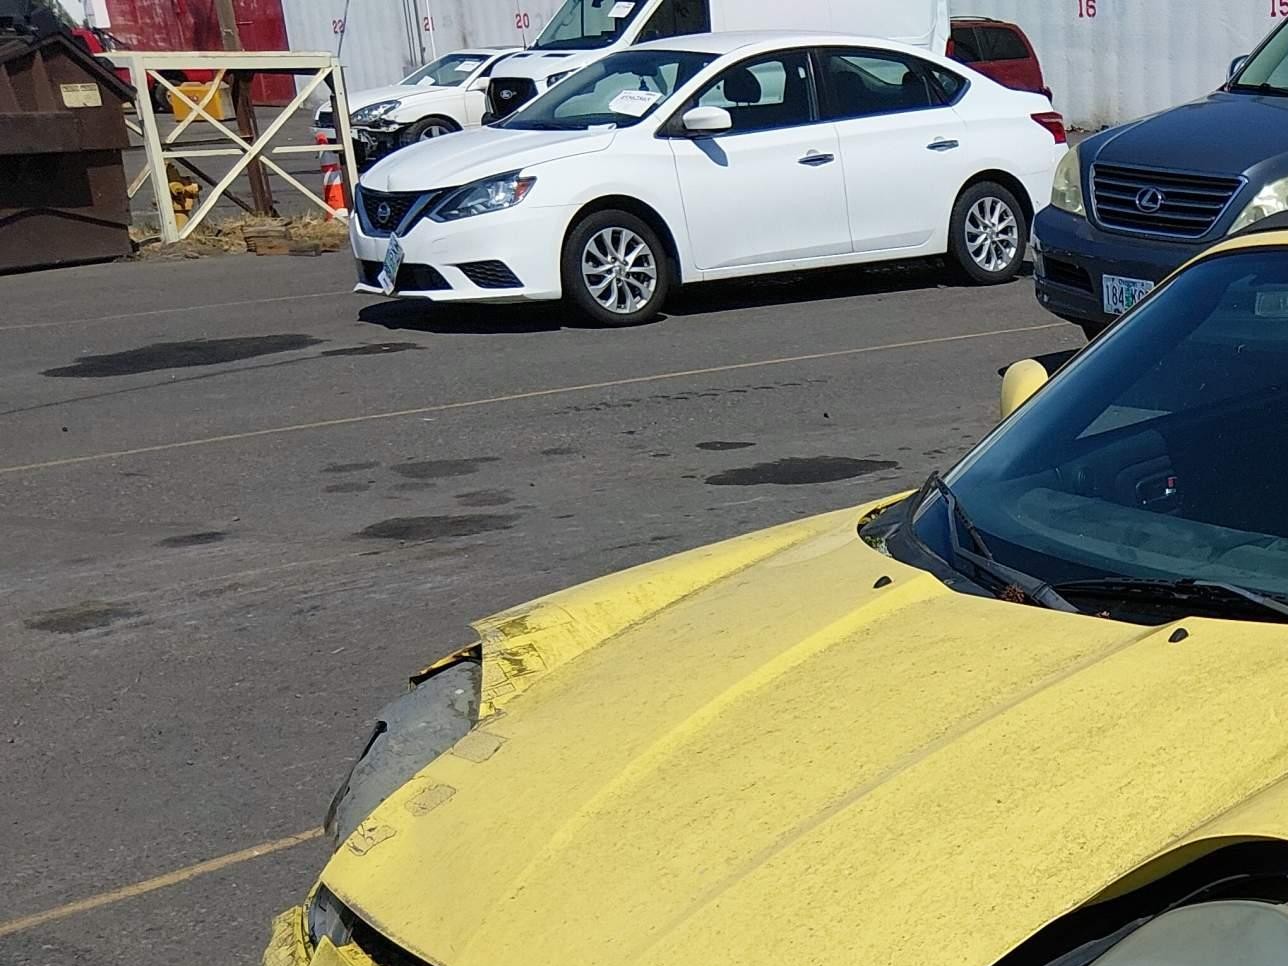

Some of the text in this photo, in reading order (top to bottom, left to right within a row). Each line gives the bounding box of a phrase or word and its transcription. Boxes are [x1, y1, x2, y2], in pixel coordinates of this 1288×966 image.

[1078, 0, 1097, 18] 16
[423, 16, 435, 32] 21
[515, 13, 530, 29] 20
[1105, 284, 1125, 308] 184
